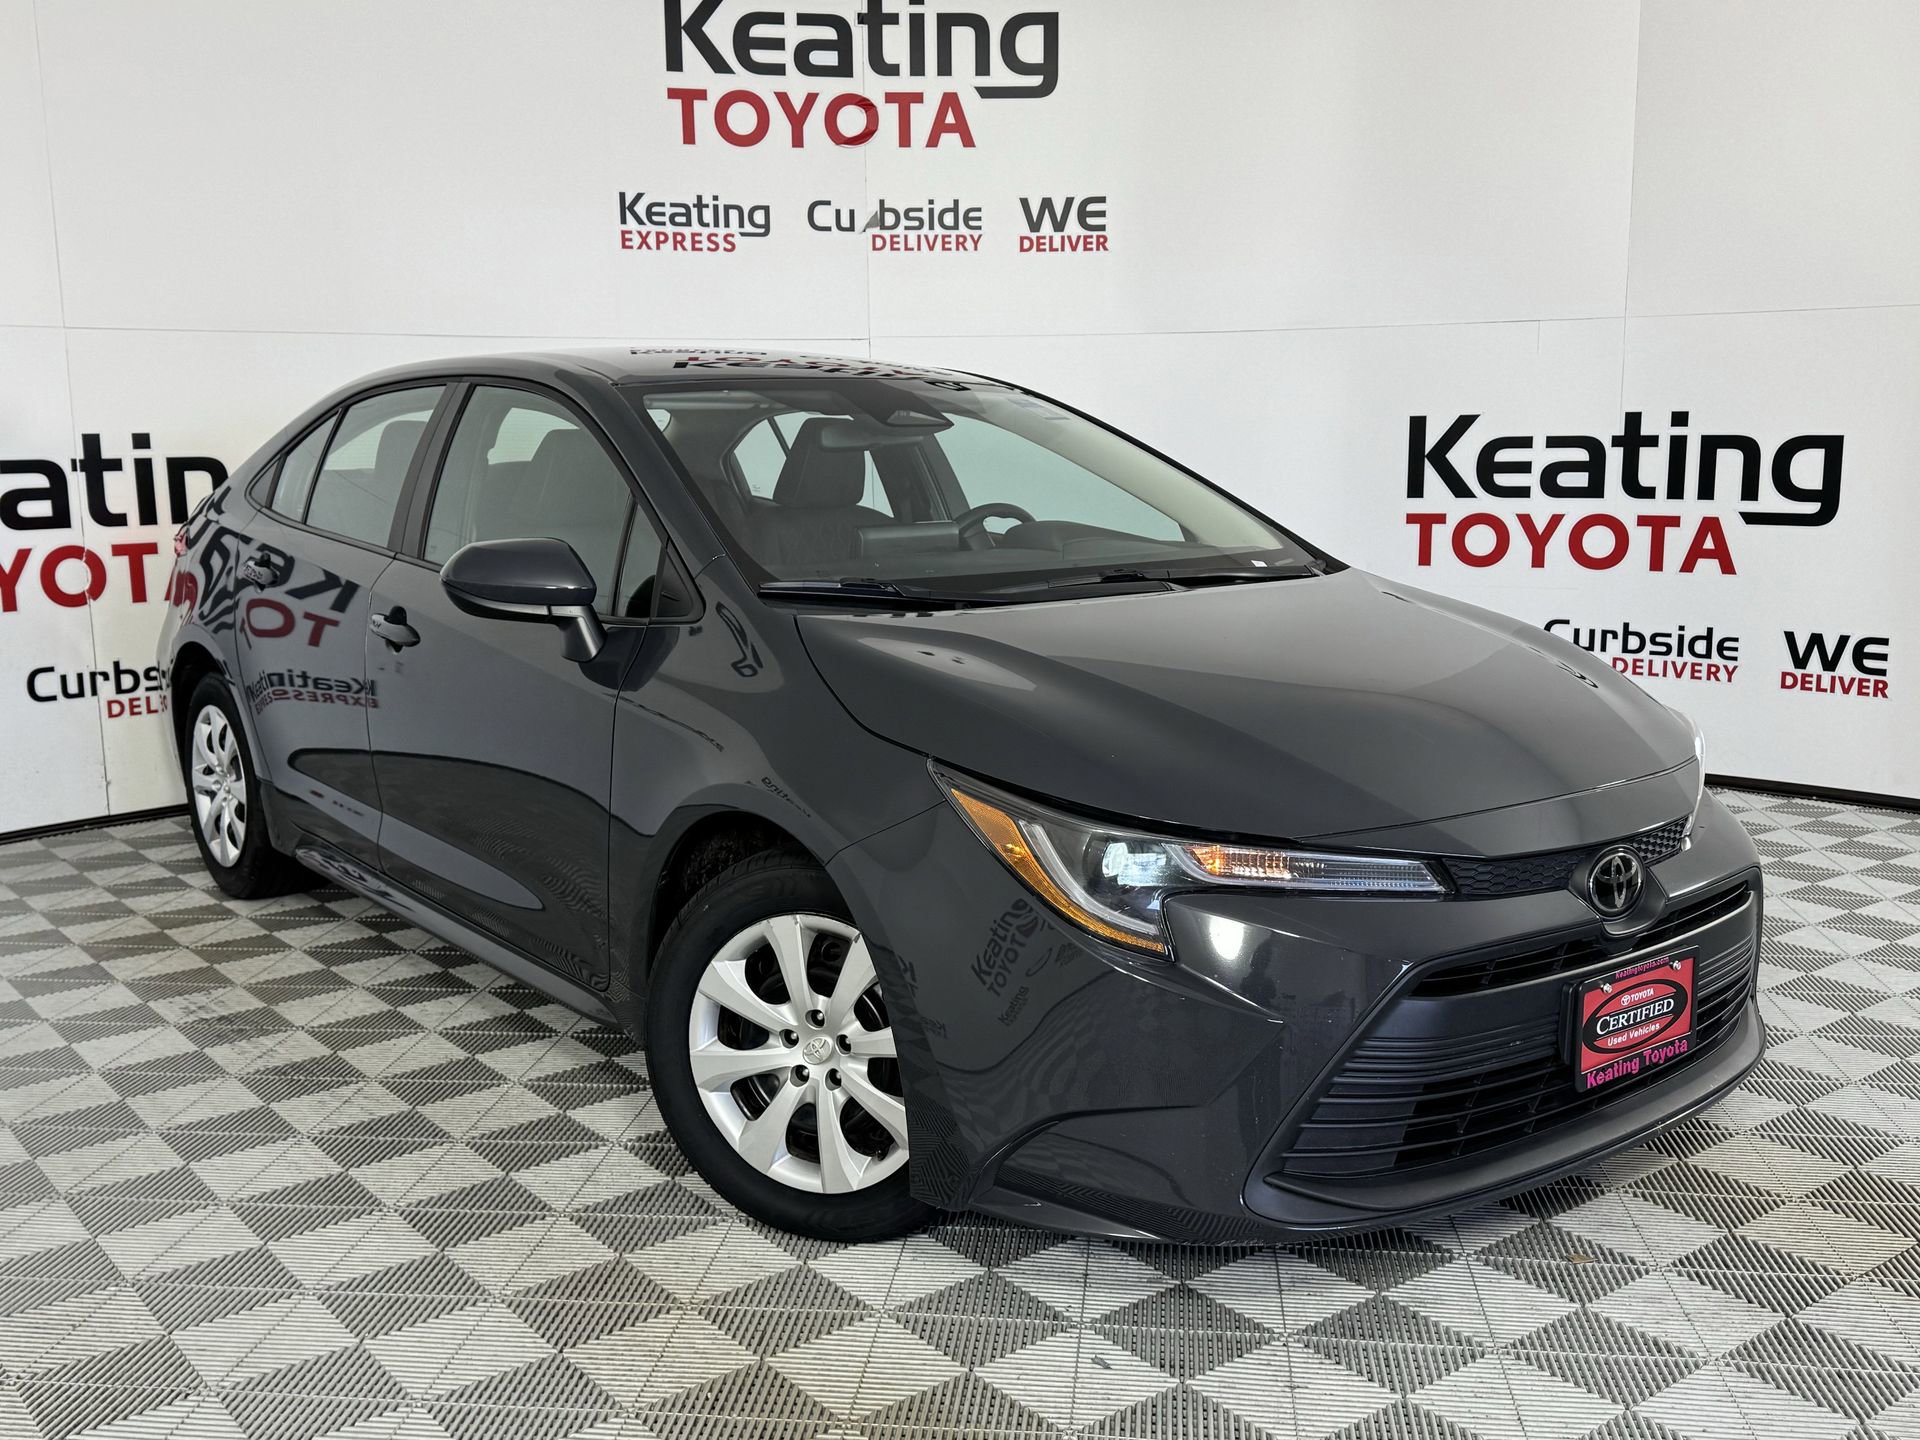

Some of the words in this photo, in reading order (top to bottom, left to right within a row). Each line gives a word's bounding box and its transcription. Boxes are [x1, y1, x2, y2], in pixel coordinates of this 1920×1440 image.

[664, 0, 1059, 99] Keating
[667, 87, 976, 148] TOYOTA
[619, 192, 770, 237] Keating
[807, 199, 982, 232] Cubside
[1019, 196, 1106, 232] WE
[620, 230, 736, 252] EXPRESS
[872, 234, 982, 251] DELIVERY
[1019, 235, 1109, 252] DELIVER
[1407, 411, 1844, 526] Keating
[1406, 513, 1737, 575] TOYOTA
[0, 542, 173, 612] YOT
[1612, 657, 1738, 683] DELIVERY
[1783, 631, 1889, 676] WE
[1780, 672, 1889, 698] DELIVER
[1631, 988, 1654, 1002] TOYOTA
[1596, 998, 1674, 1035] CERTIFIED
[1607, 1033, 1627, 1046] Used
[1629, 1022, 1660, 1039] Vehicles
[1586, 1056, 1640, 1089] Keating
[1643, 1039, 1688, 1065] Toyota
